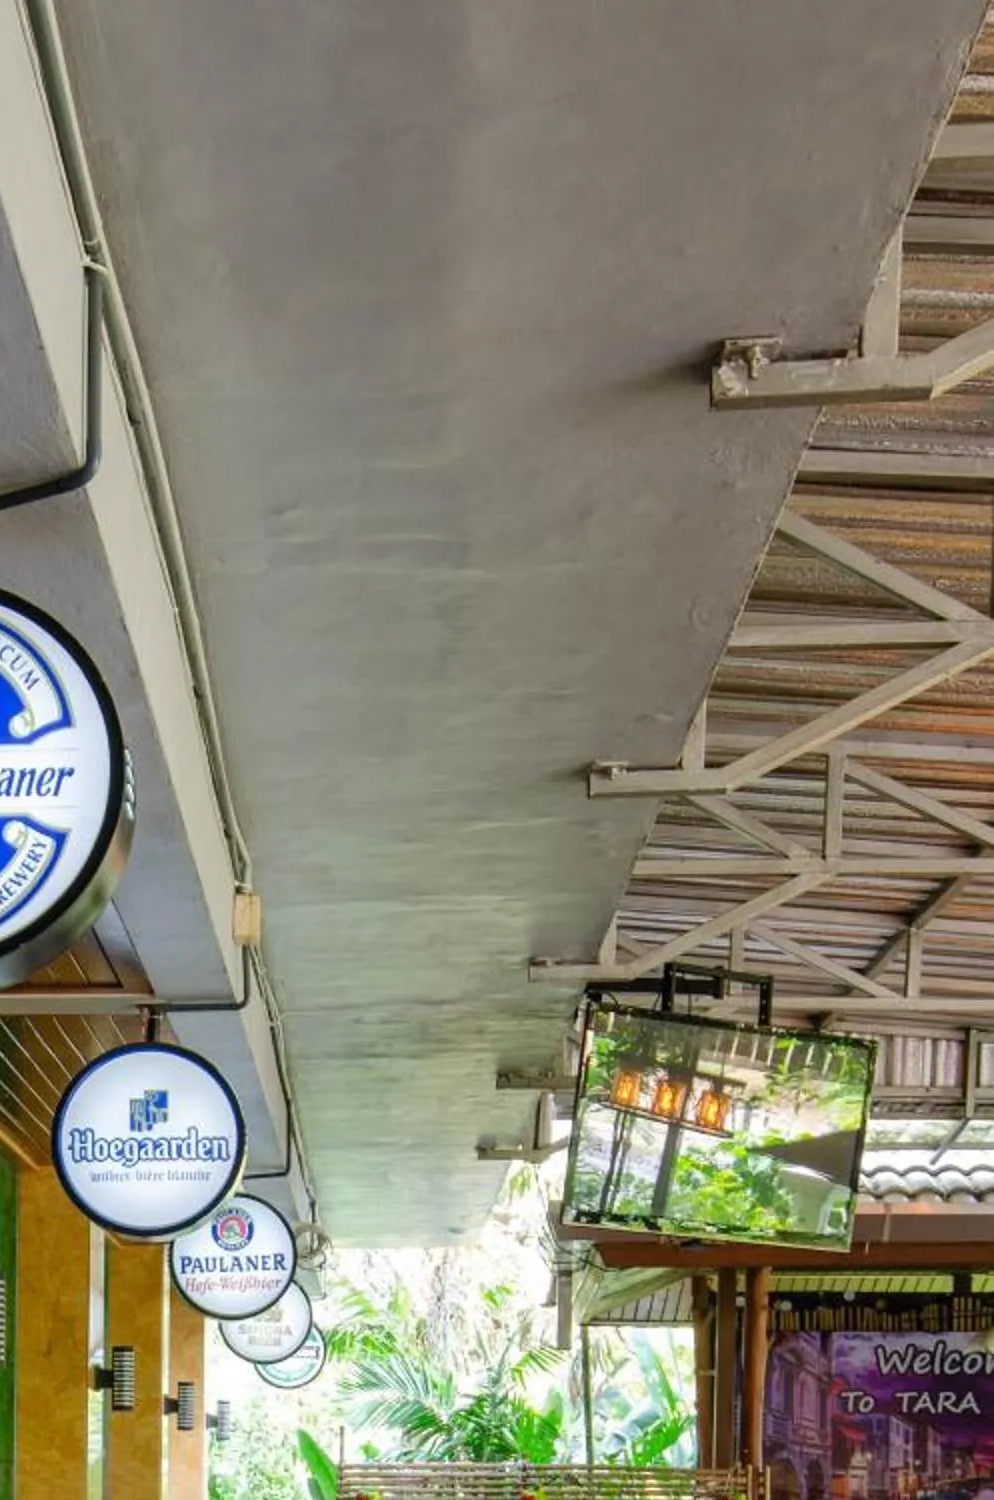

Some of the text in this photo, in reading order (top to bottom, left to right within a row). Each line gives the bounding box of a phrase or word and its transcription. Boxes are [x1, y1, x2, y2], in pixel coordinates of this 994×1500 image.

[68, 1126, 231, 1168] Hoegaarden
[179, 1252, 288, 1275] PAULANER
[840, 1391, 982, 1415] To TARA
